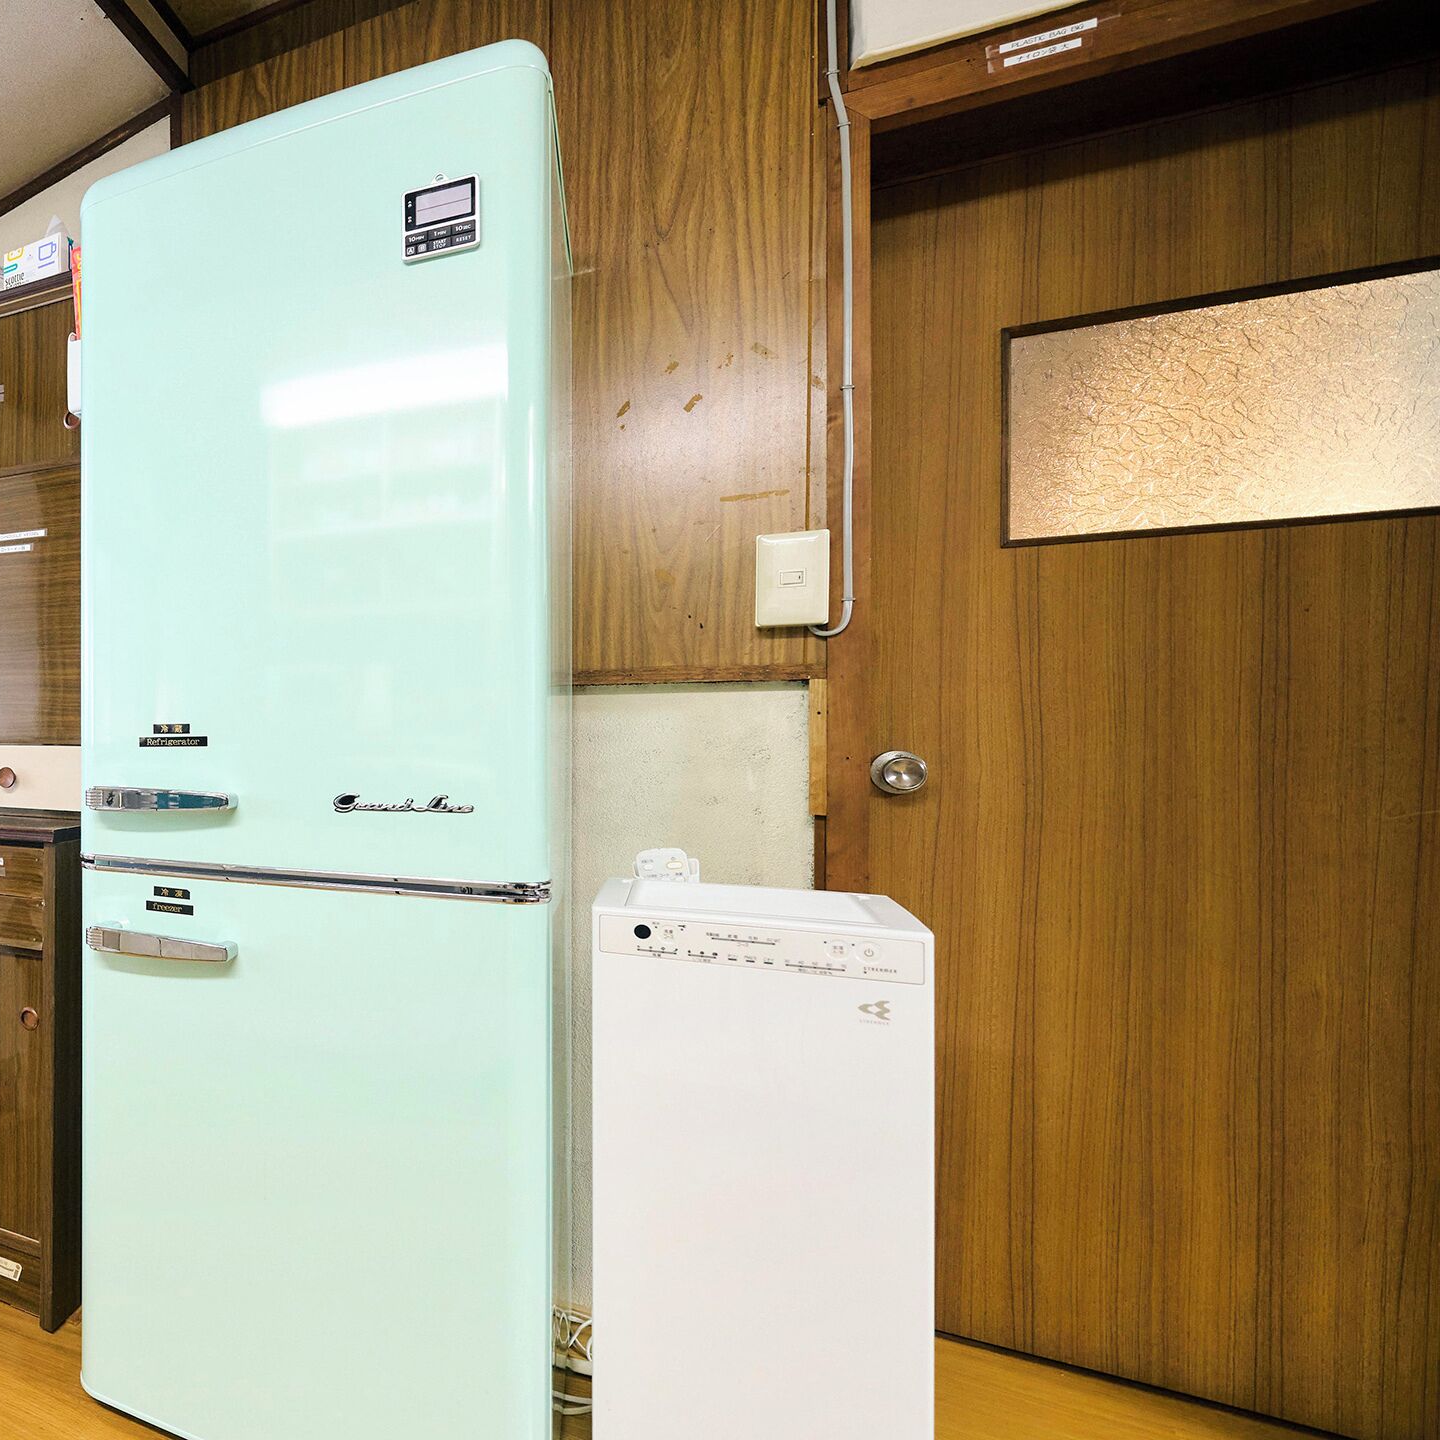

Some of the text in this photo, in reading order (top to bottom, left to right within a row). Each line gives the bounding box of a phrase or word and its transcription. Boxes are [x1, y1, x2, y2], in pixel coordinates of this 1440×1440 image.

[1011, 34, 1045, 48] PLASTIC
[1048, 28, 1067, 39] BAG
[146, 737, 200, 747] Refrigerator
